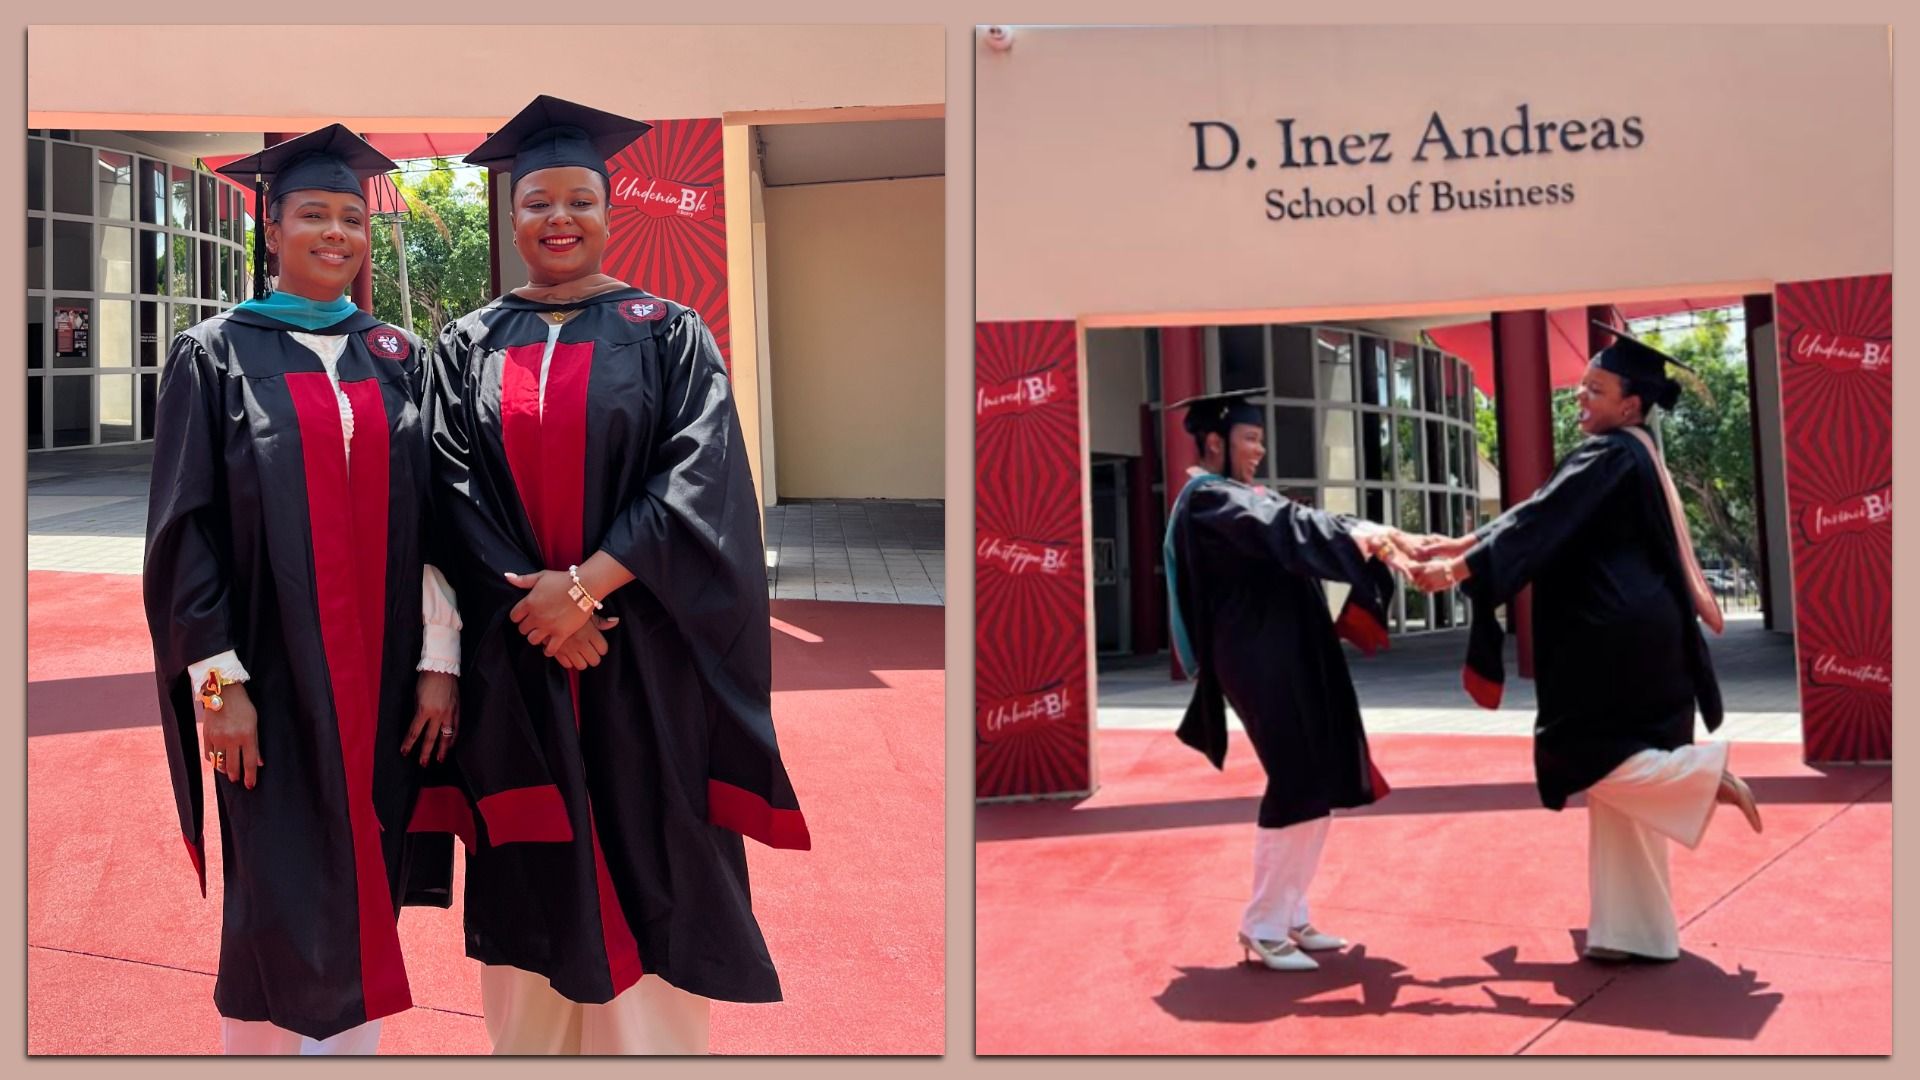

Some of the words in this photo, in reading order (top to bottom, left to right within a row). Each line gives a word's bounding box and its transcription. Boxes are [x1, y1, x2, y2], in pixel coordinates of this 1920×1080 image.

[1189, 121, 1256, 172] D.
[1276, 118, 1393, 169] Inez
[1411, 104, 1645, 163] Andreas
[615, 176, 708, 213] UndeniaBle
[1265, 184, 1375, 221] School
[1387, 181, 1421, 214] of
[1430, 178, 1575, 213] Business
